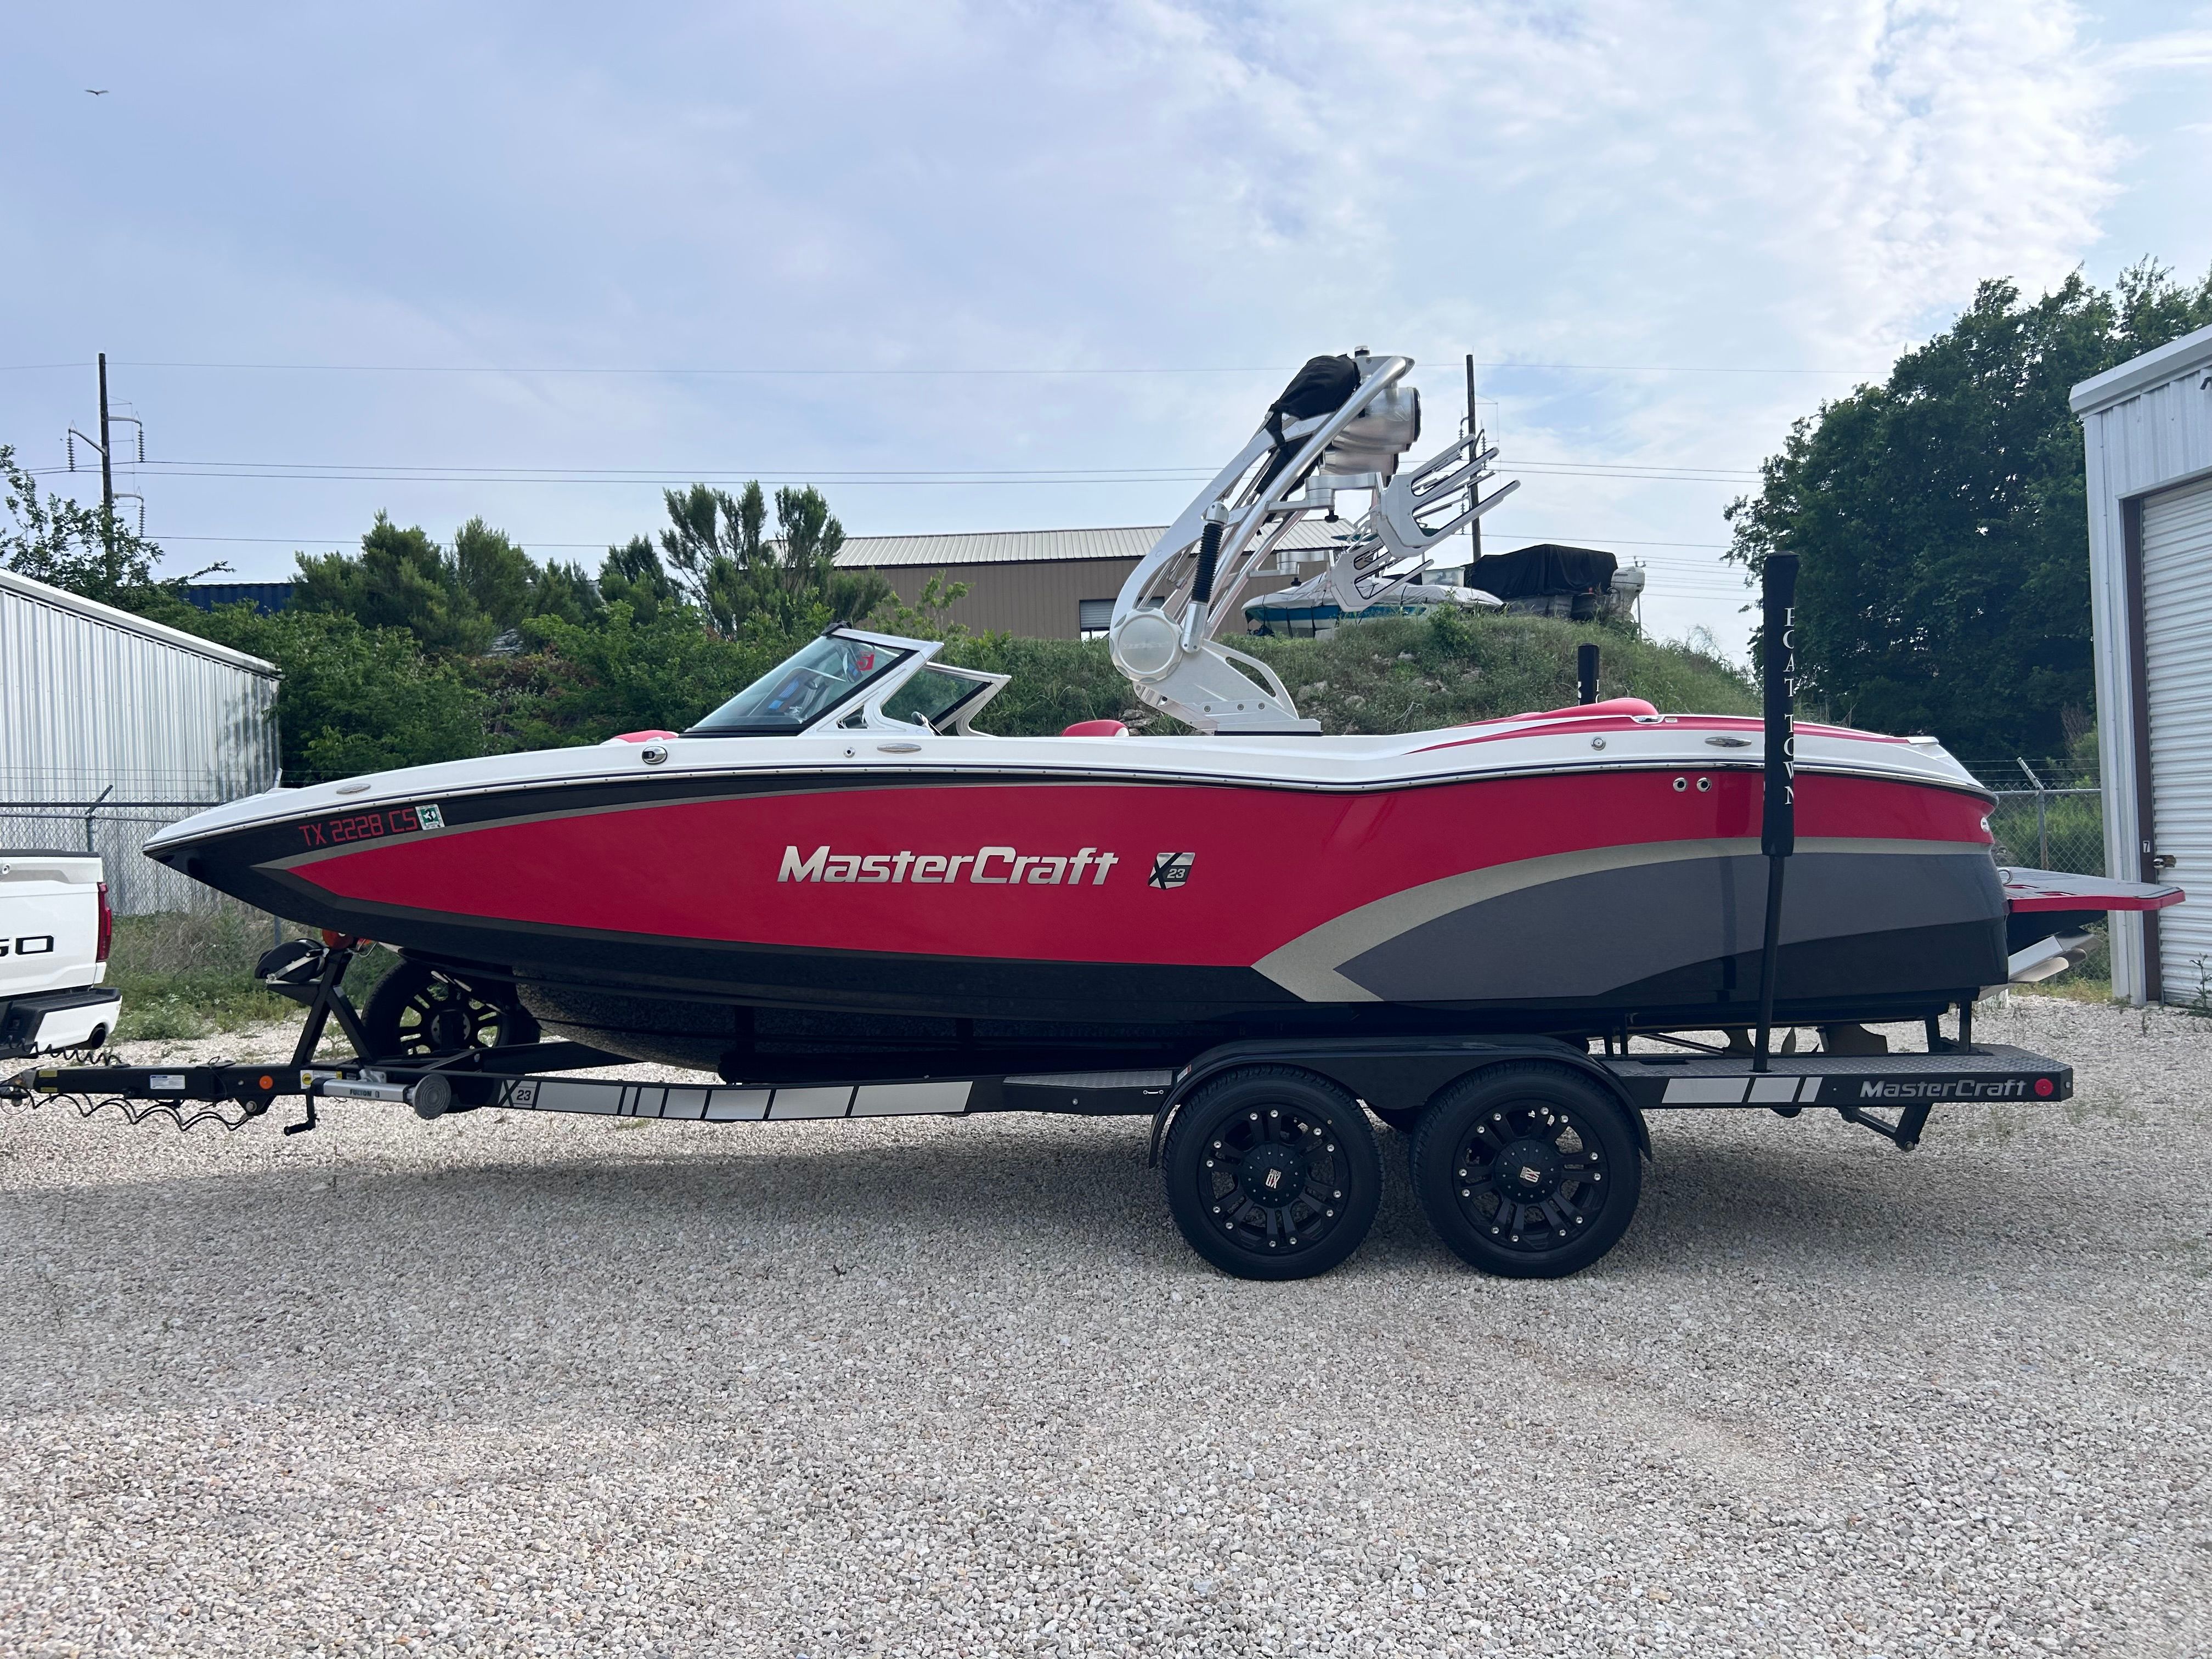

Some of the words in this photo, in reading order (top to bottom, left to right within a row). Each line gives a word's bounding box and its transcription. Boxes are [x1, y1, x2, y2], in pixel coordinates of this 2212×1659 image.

[298, 823, 327, 846] TX
[330, 814, 383, 842] 2228
[388, 808, 418, 833] CS
[2144, 841, 2149, 852] 7
[777, 845, 1119, 885] MasterCraft
[349, 1088, 372, 1097] FULTON
[1860, 1079, 2027, 1098] MasterCraft
